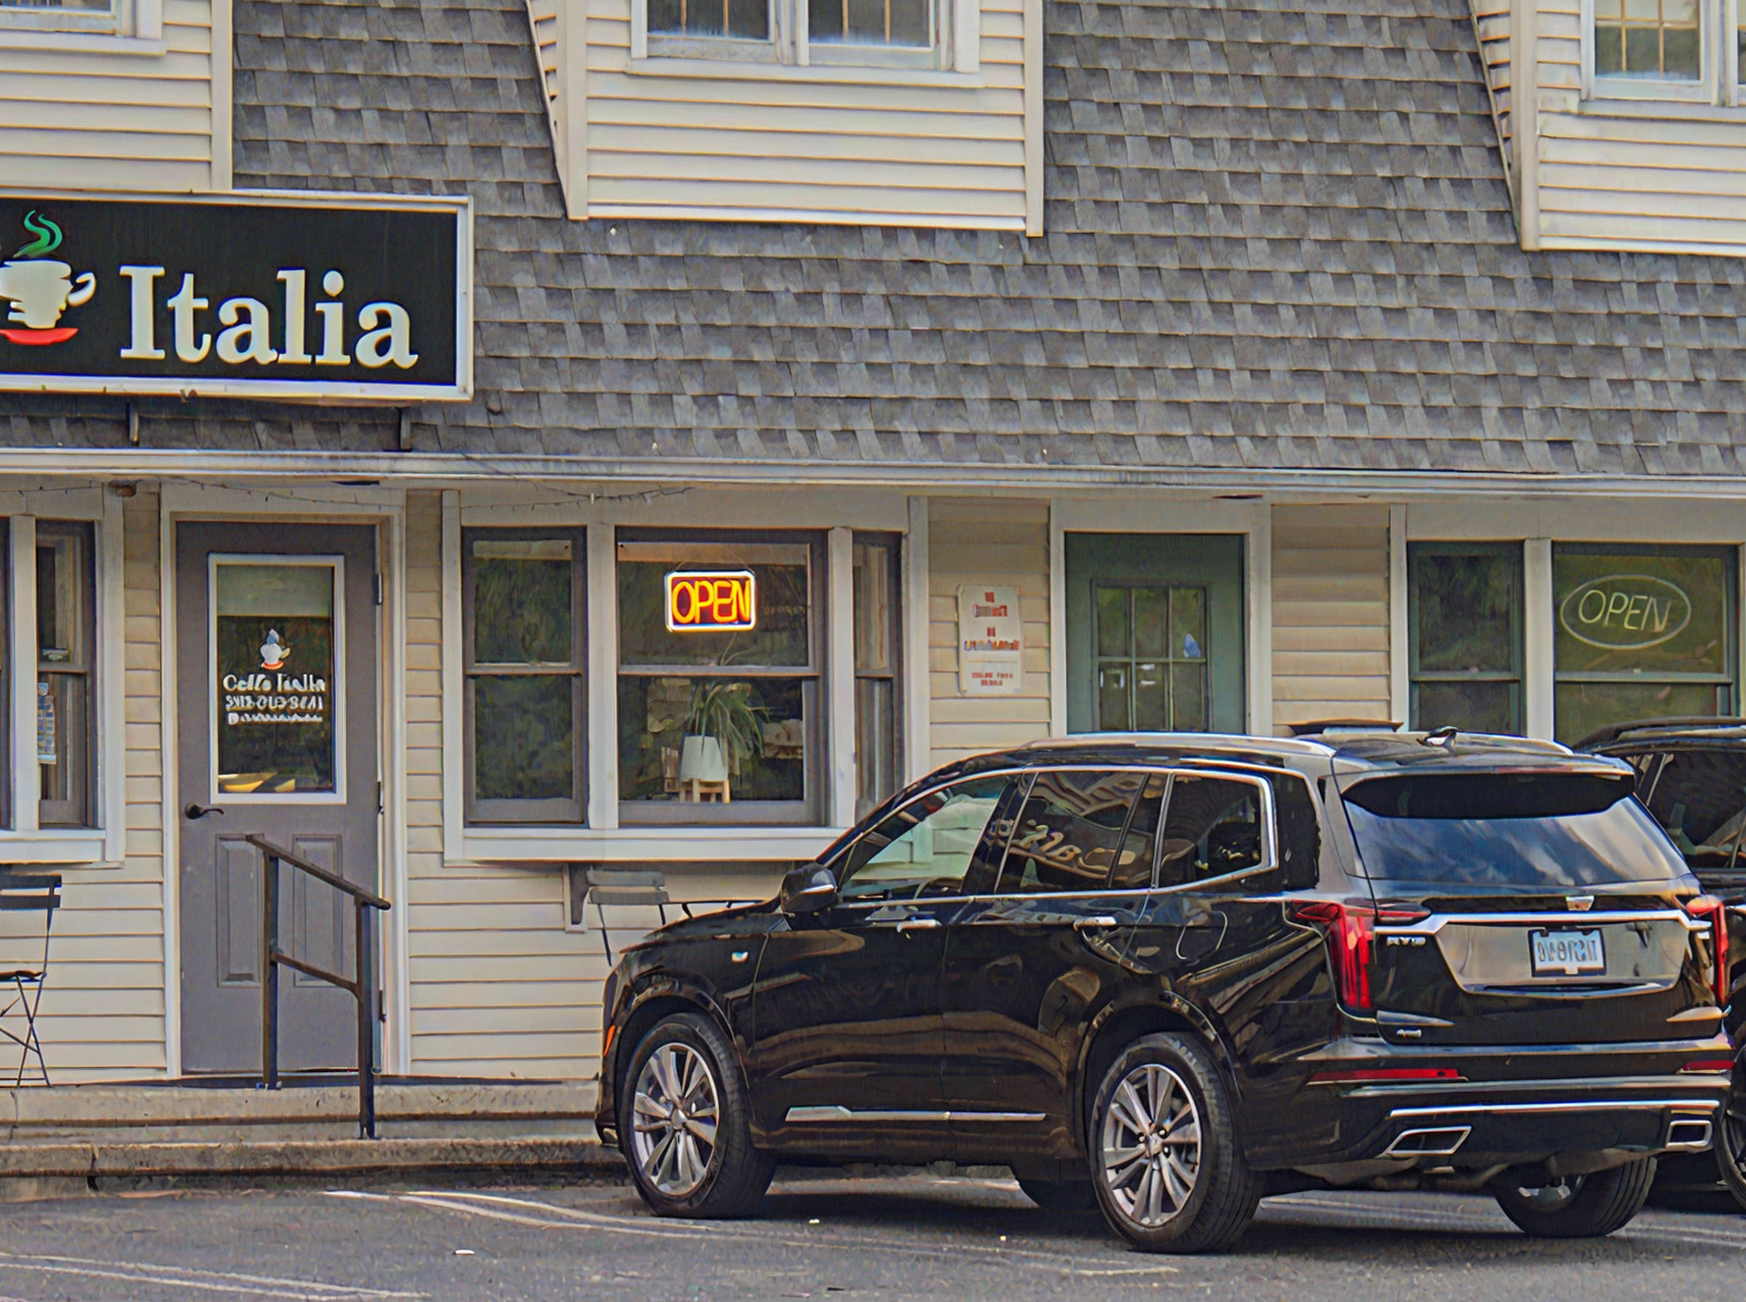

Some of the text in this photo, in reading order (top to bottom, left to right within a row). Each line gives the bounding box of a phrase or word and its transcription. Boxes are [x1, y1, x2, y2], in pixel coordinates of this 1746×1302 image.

[119, 264, 420, 369] Italia
[671, 579, 751, 624] OPEN
[1579, 589, 1672, 633] OPEN
